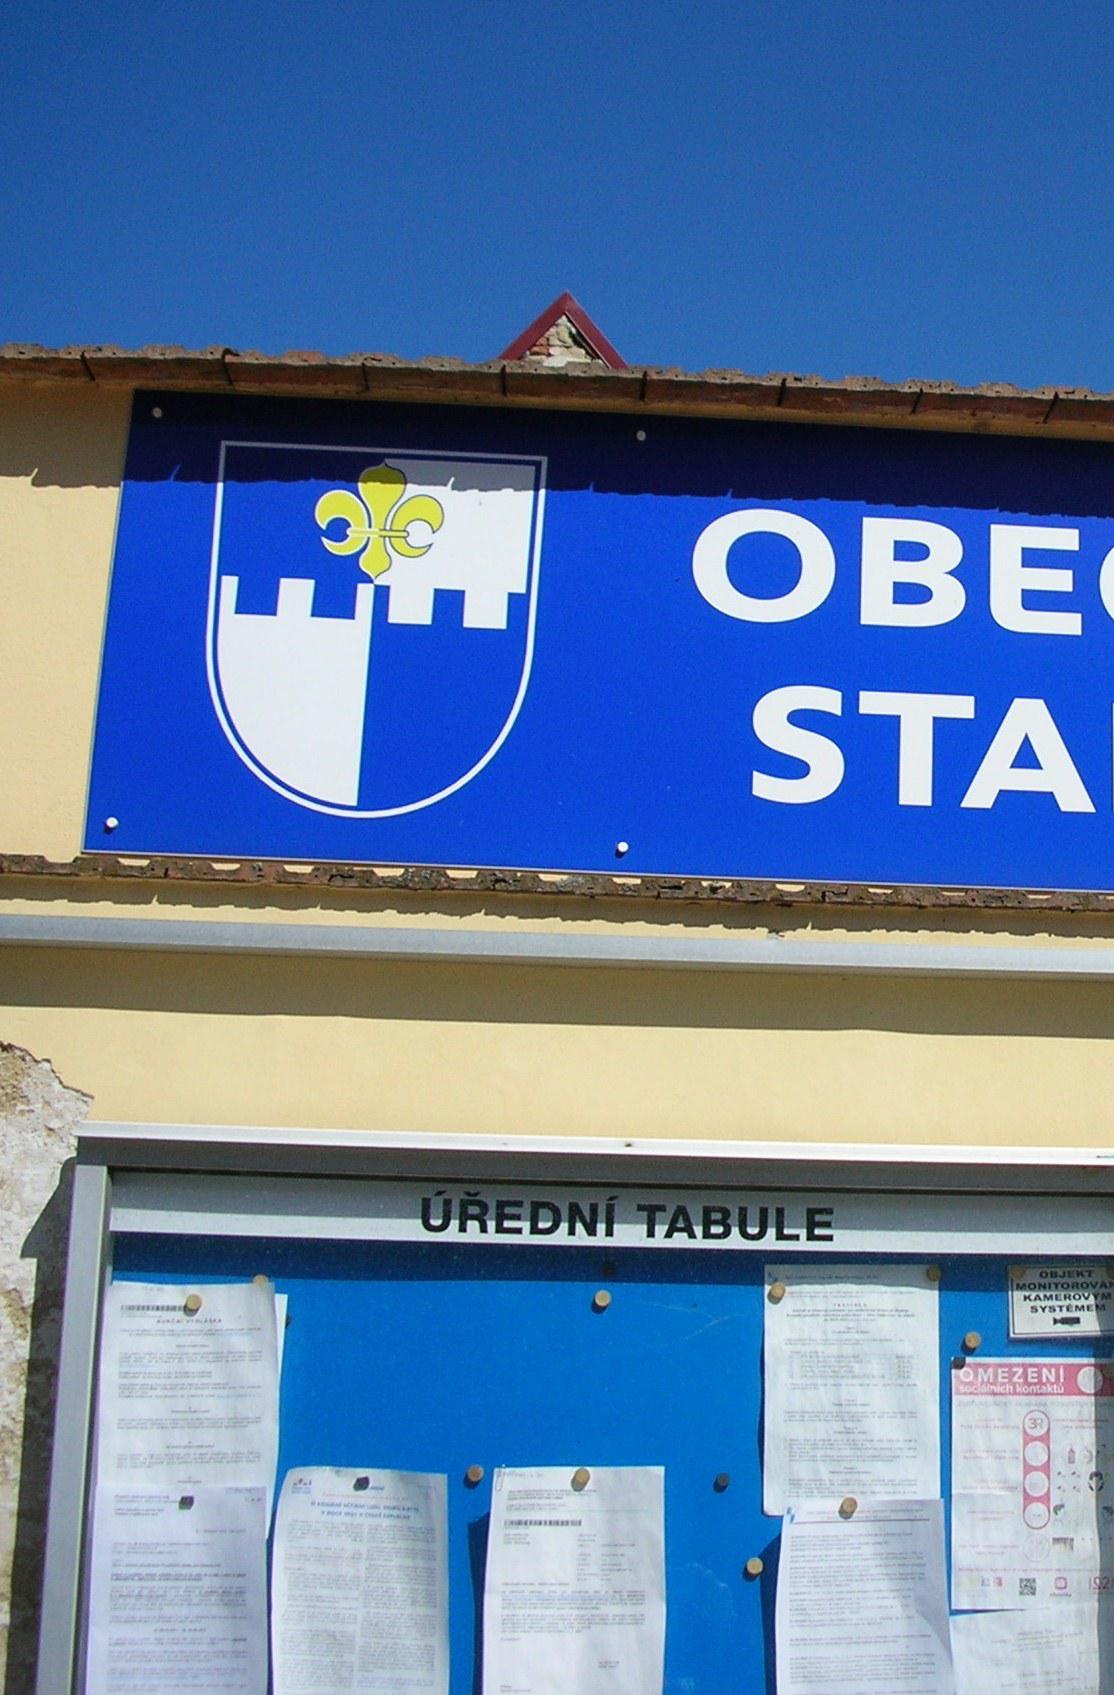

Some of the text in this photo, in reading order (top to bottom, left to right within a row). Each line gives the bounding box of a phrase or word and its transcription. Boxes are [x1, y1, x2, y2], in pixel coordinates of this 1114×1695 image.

[420, 1190, 835, 1242] ÚŘEDNÍ TABULE
[1039, 1270, 1094, 1279] OBJEKT
[959, 1365, 1065, 1383] OMEZENÍ
[959, 1383, 1065, 1394] sociálních kontaktů
